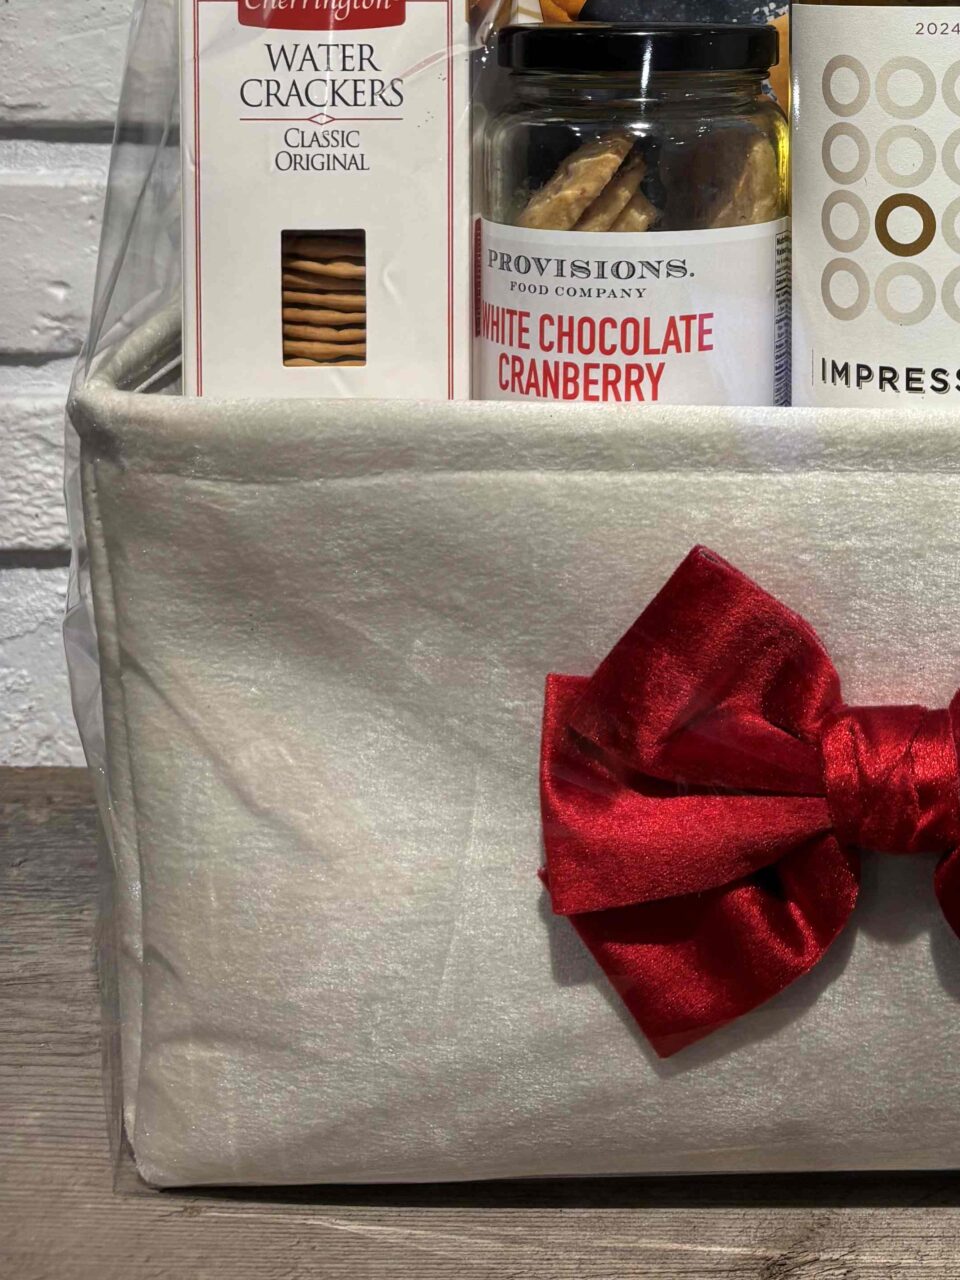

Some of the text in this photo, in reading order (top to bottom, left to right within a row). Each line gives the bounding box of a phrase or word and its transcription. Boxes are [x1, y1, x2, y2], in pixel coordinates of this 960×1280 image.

[264, 43, 382, 72] WATER
[239, 77, 404, 107] CRACKERS
[284, 127, 360, 148] CLASSIC
[275, 150, 370, 171] ORIGINAL
[487, 248, 695, 280] PROVISIONS.
[510, 281, 647, 299] FOOD COMPANY
[482, 299, 714, 356] WHITE CHOCOLATE
[498, 352, 666, 402] CRANBERRY
